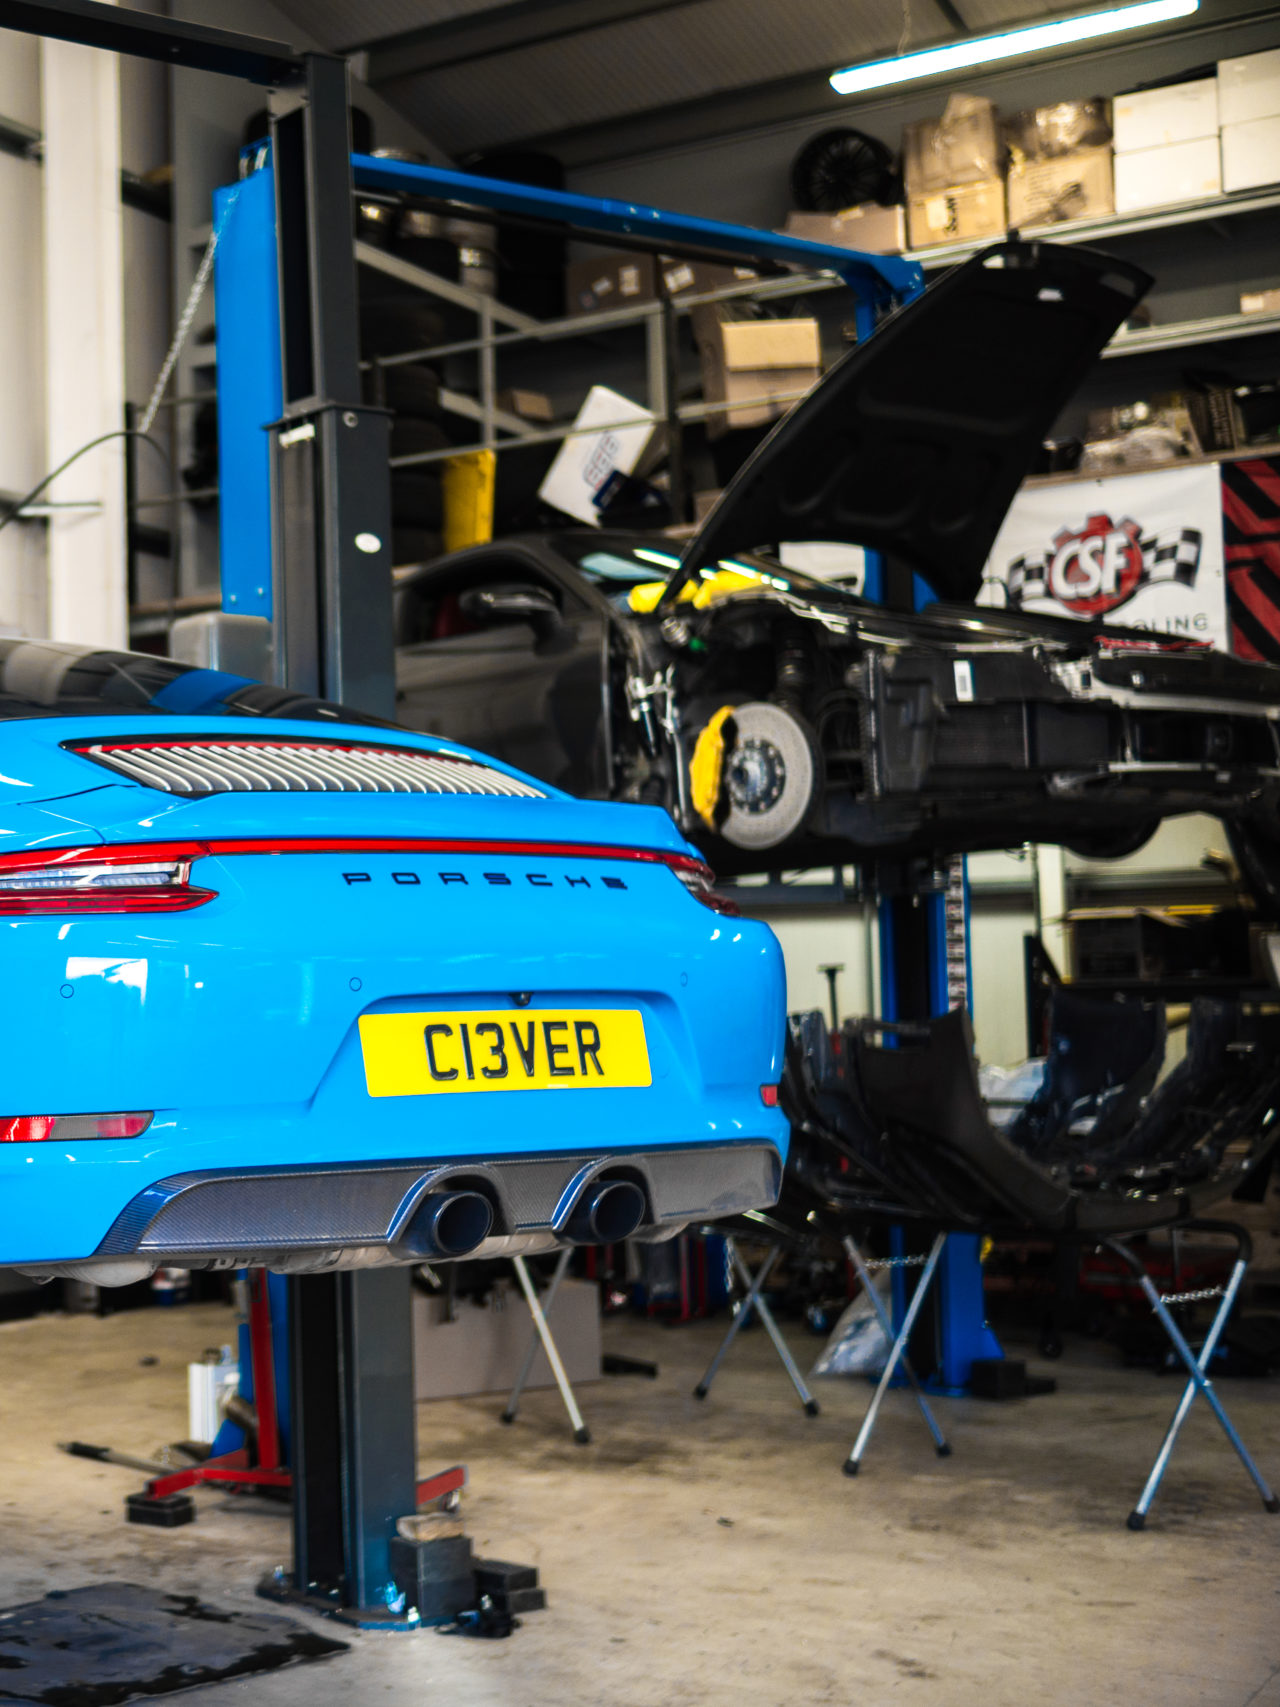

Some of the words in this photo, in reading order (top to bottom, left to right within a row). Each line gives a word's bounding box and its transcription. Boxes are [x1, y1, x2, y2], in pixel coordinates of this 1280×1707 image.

[1051, 531, 1128, 599] CSF
[342, 872, 628, 890] PORSCHE
[423, 1020, 605, 1082] C13VER
